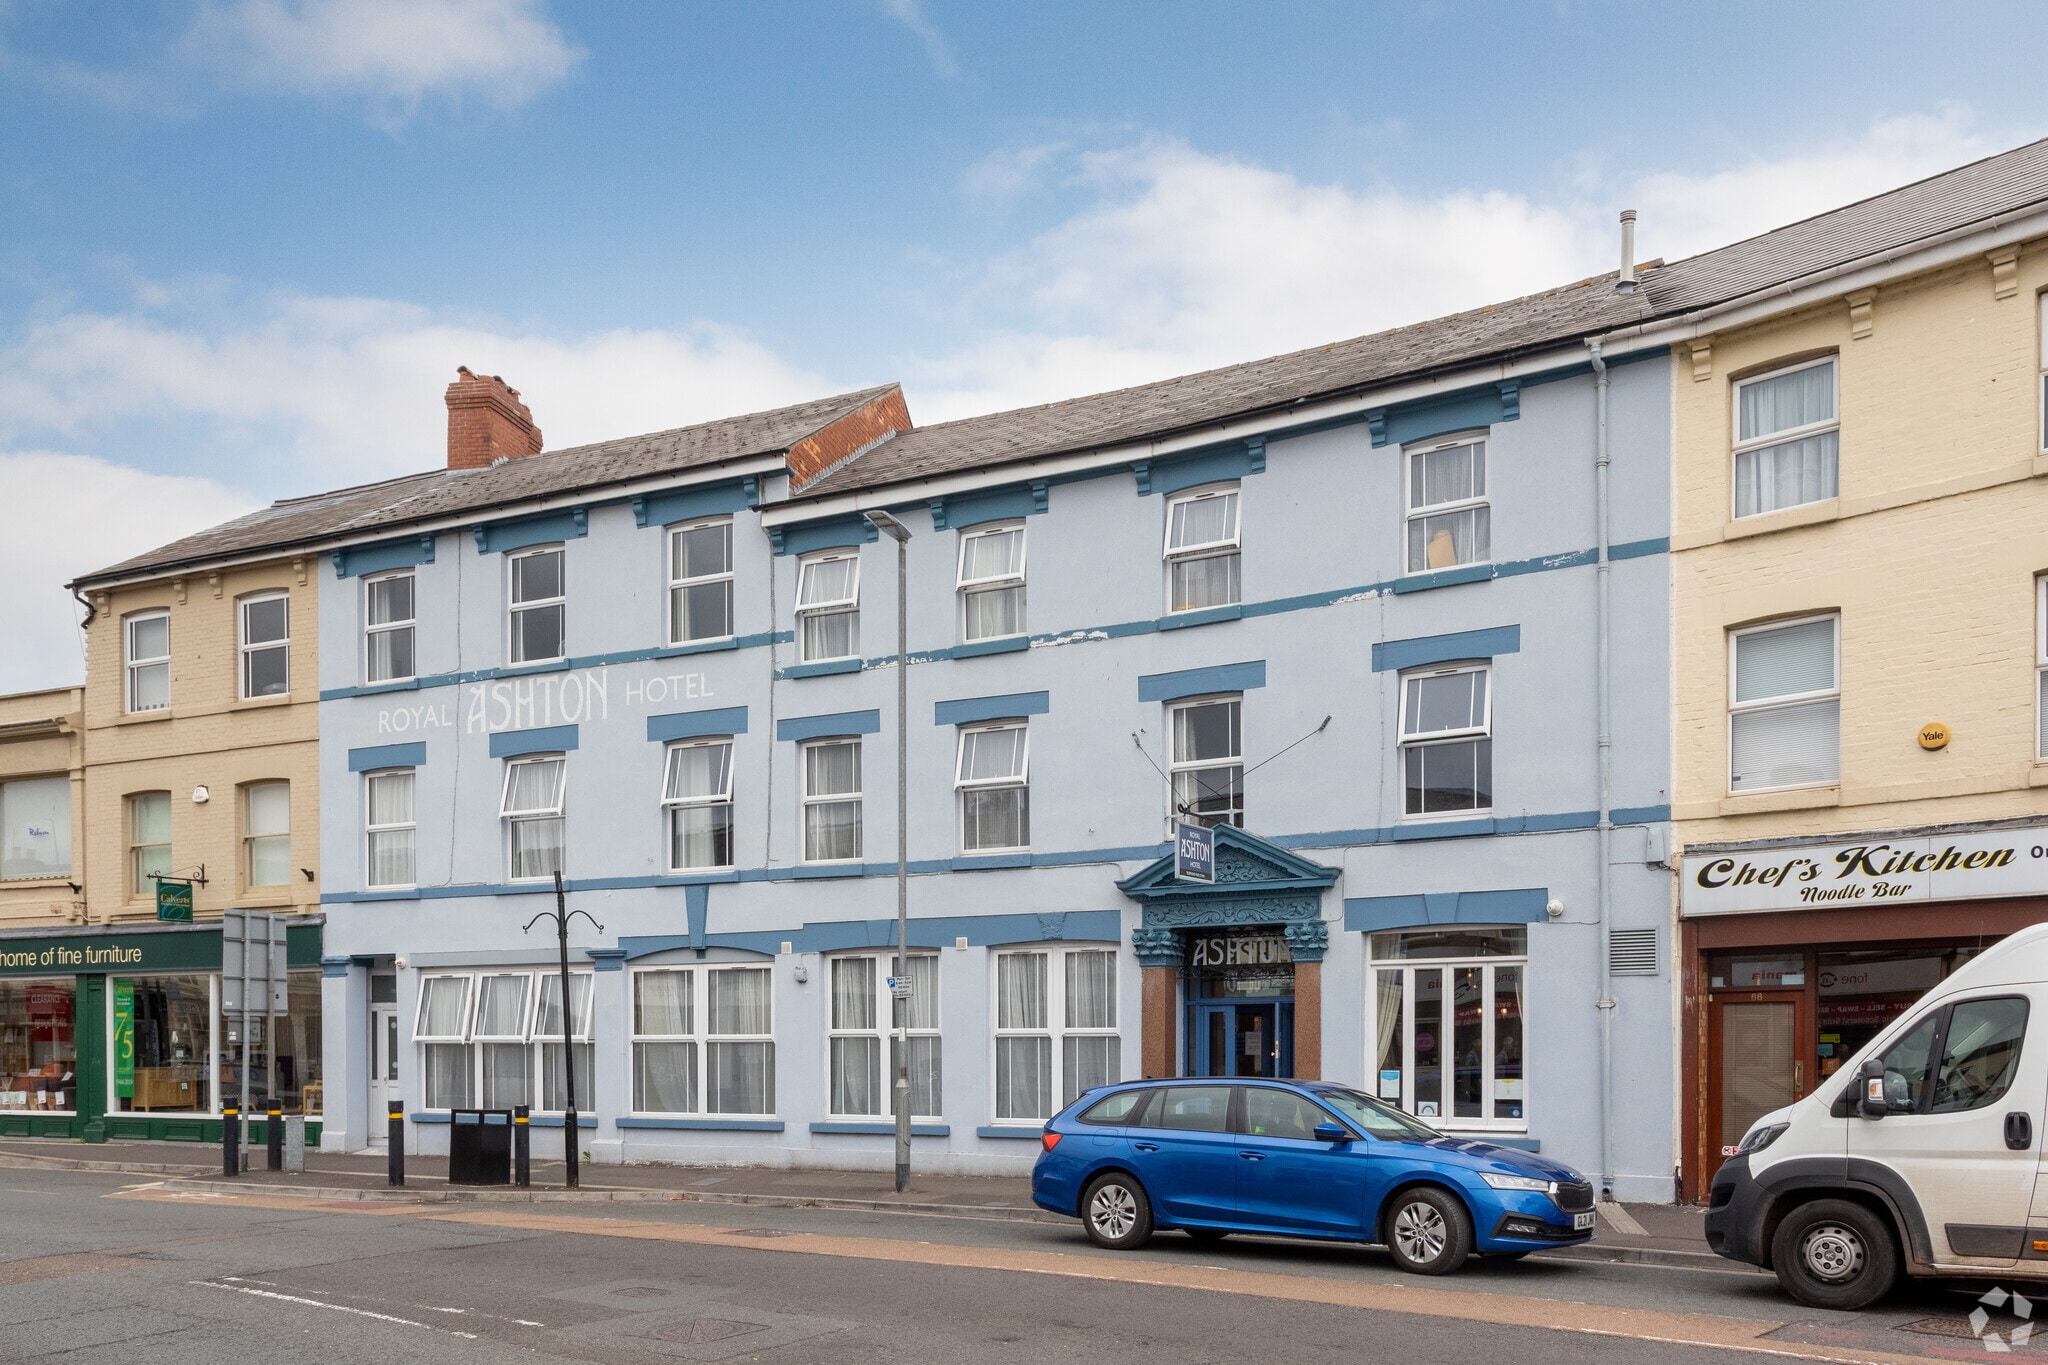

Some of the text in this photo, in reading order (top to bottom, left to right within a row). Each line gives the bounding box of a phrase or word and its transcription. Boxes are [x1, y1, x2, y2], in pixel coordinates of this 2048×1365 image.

[378, 669, 714, 734] ROYAL ASHTON HOTEL
[1922, 731, 1944, 741] Yale
[1180, 838, 1210, 862] ASHTON
[2030, 845, 2048, 859] O
[1695, 844, 2017, 889] Chef's Kitchen
[1799, 881, 1913, 904] Noodle Bar
[0, 945, 142, 967] home of fine furniture
[1192, 936, 1293, 966] ASHTON
[31, 994, 61, 1004] CLEARANCE
[1751, 992, 1763, 1001] 88
